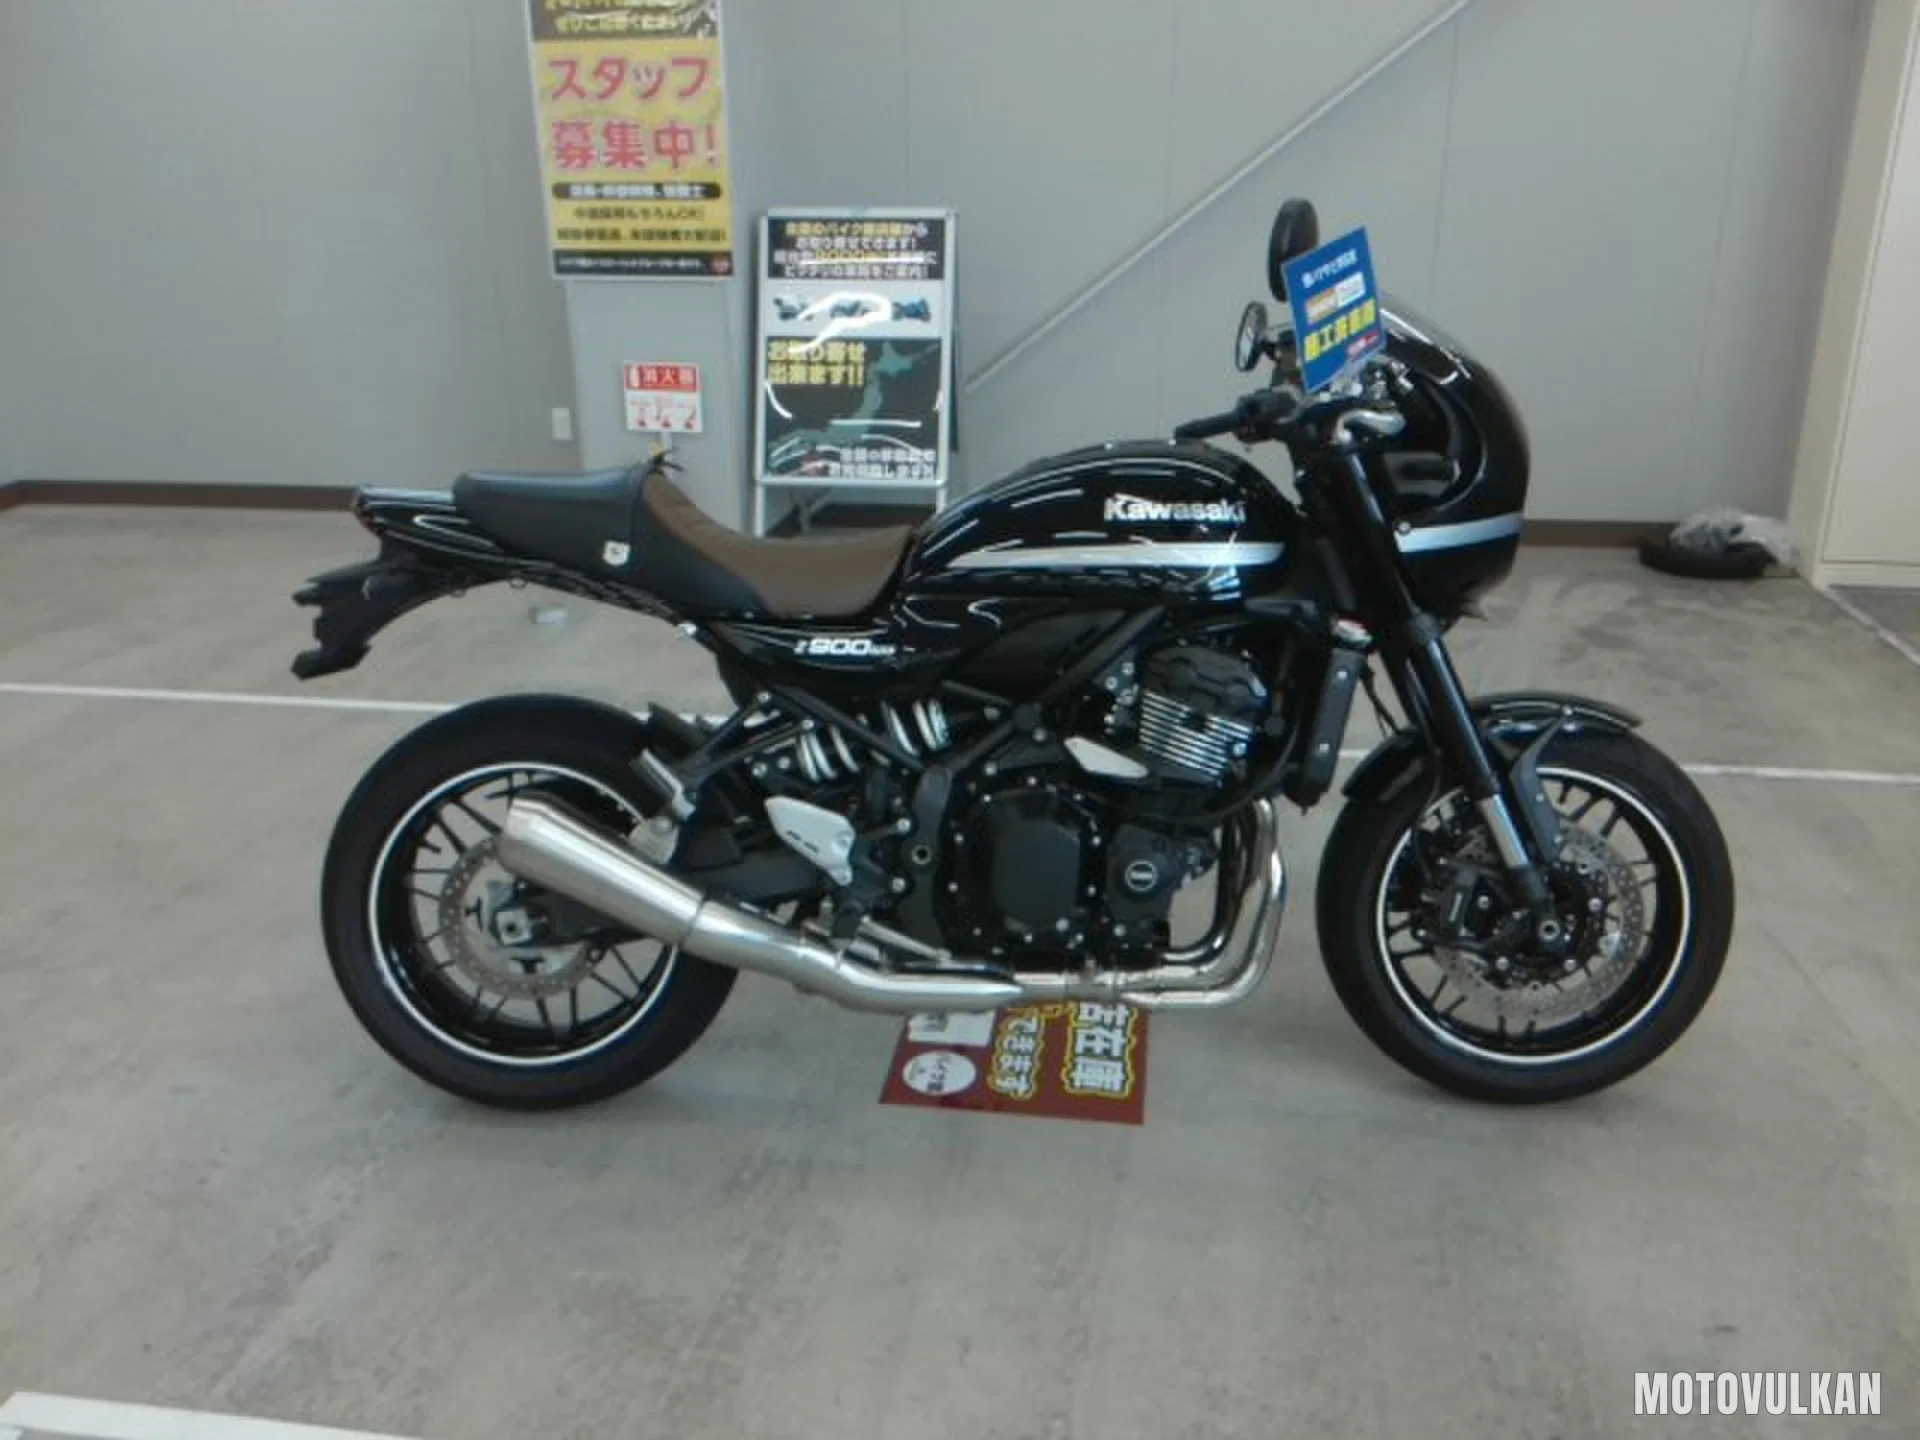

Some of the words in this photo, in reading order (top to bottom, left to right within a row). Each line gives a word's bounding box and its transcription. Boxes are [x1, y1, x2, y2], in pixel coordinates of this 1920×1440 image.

[548, 57, 709, 101] スタッフ
[551, 120, 719, 169] 募集中!
[1103, 498, 1246, 522] Kawasaki
[995, 1017, 1037, 1096] できます
